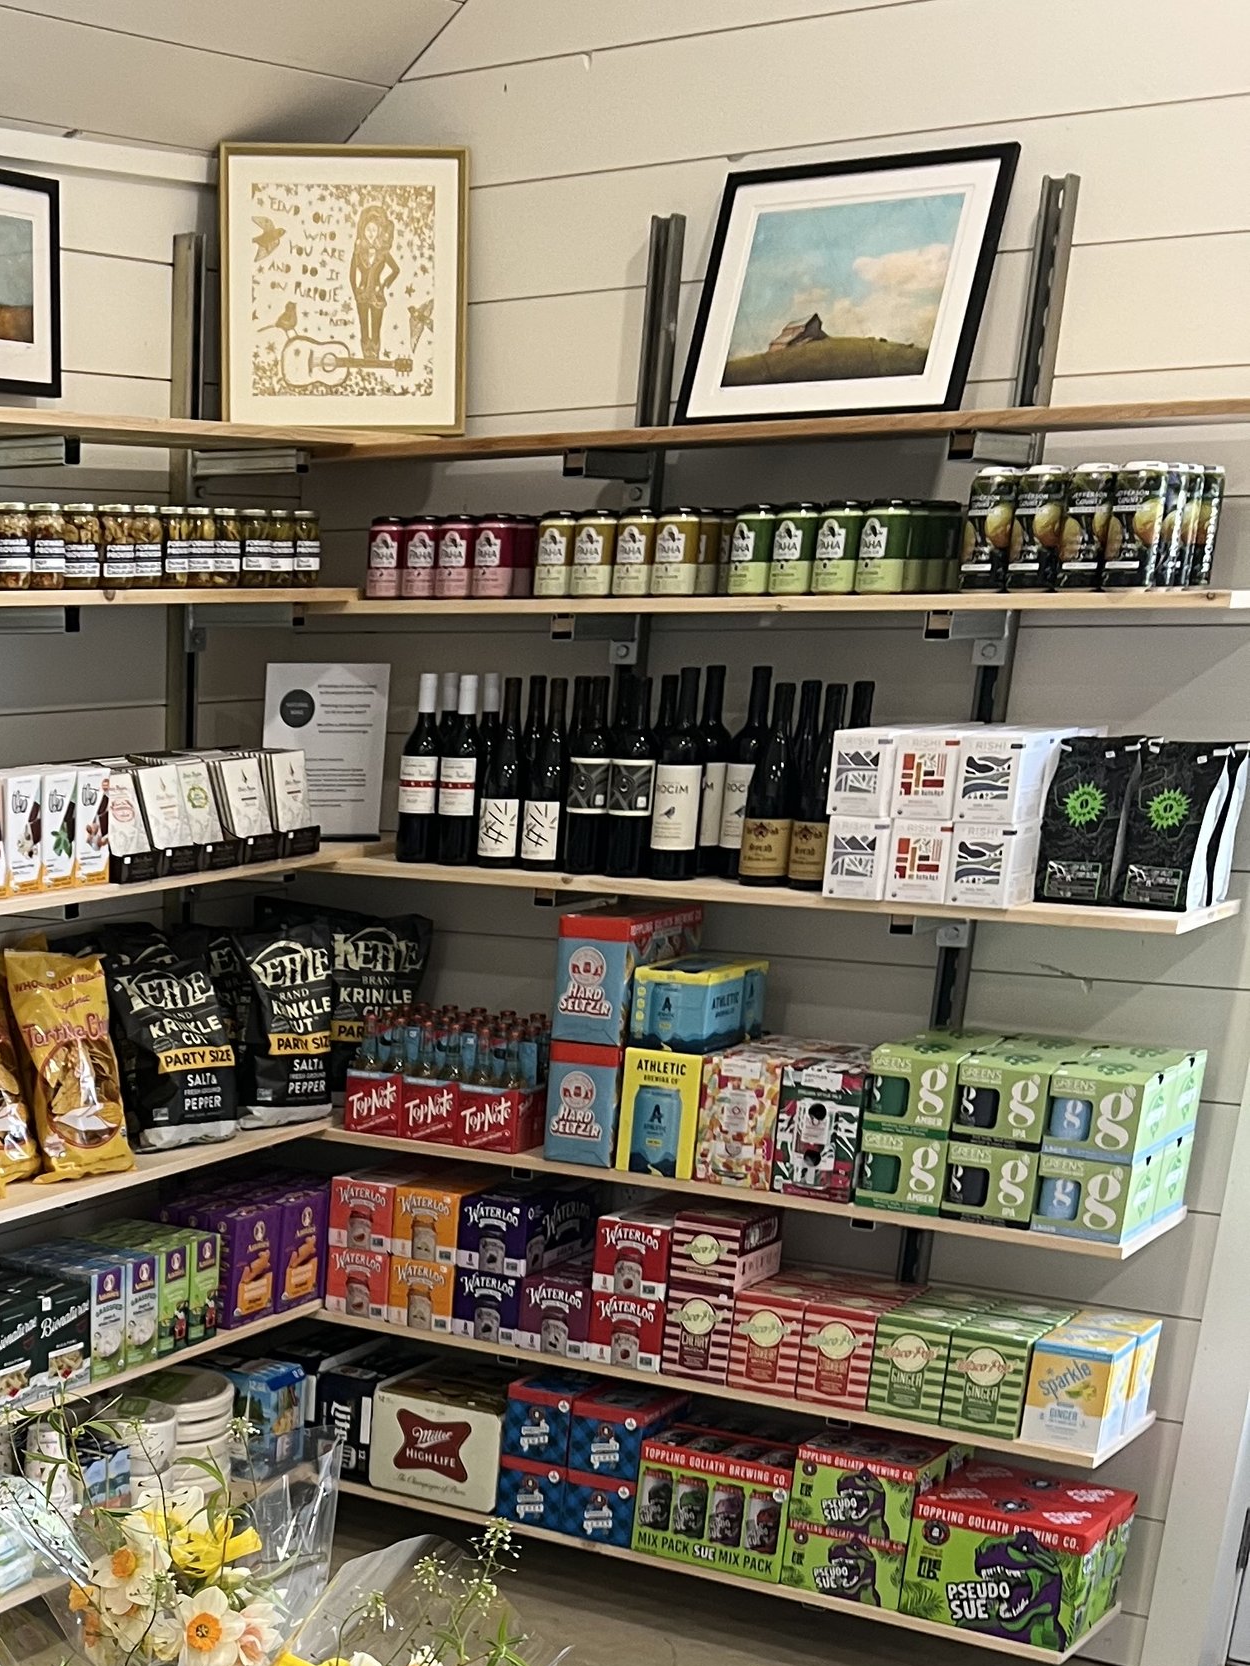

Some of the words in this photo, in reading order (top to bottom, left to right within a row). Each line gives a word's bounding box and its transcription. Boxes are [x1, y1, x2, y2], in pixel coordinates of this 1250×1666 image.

[289, 240, 313, 257] YOU
[321, 247, 345, 261] ARE
[568, 982, 602, 999] HARD
[164, 1051, 207, 1068] PARTY
[210, 1049, 232, 1063] SIZE
[637, 1059, 686, 1076] ATHLETIC
[962, 1065, 1003, 1080] GREENS
[288, 1080, 326, 1094] PEPPER
[184, 1095, 222, 1110] PEPPER
[559, 1108, 592, 1124] HARD
[1094, 1084, 1136, 1151] g
[338, 1185, 386, 1207] WATERLOO
[398, 1193, 451, 1216] WATERLOO
[465, 1201, 519, 1227] WATERLOO
[602, 1223, 659, 1250] WATERLOO
[331, 1251, 381, 1272] WATERLOO
[460, 1272, 514, 1298] WATERLOO
[526, 1284, 582, 1310] WATERLOO
[597, 1296, 654, 1323] WATERLOO
[891, 1369, 924, 1387] GINGER
[1040, 1360, 1092, 1401] Sparkle
[965, 1385, 998, 1403] GINGER
[412, 1427, 453, 1446] Miller
[406, 1447, 432, 1464] HIGH
[434, 1453, 456, 1468] LIFE
[645, 1447, 686, 1465] TOPPLING
[689, 1456, 726, 1473] GOLIATH
[729, 1464, 769, 1482] BREWING
[773, 1474, 789, 1486] CO.
[798, 1448, 832, 1464] TOPPLING
[824, 1509, 845, 1521] SUE
[918, 1505, 964, 1525] TOPPLING
[968, 1515, 1009, 1536] GOLIATH
[1063, 1536, 1080, 1551] CO.
[638, 1531, 658, 1548] MIX
[661, 1537, 690, 1556] PACK
[719, 1549, 740, 1566] MIX
[743, 1555, 773, 1574] PACK
[815, 1576, 836, 1588] SUE
[948, 1581, 1010, 1600] PSEUDO
[951, 1598, 989, 1620] SUE
